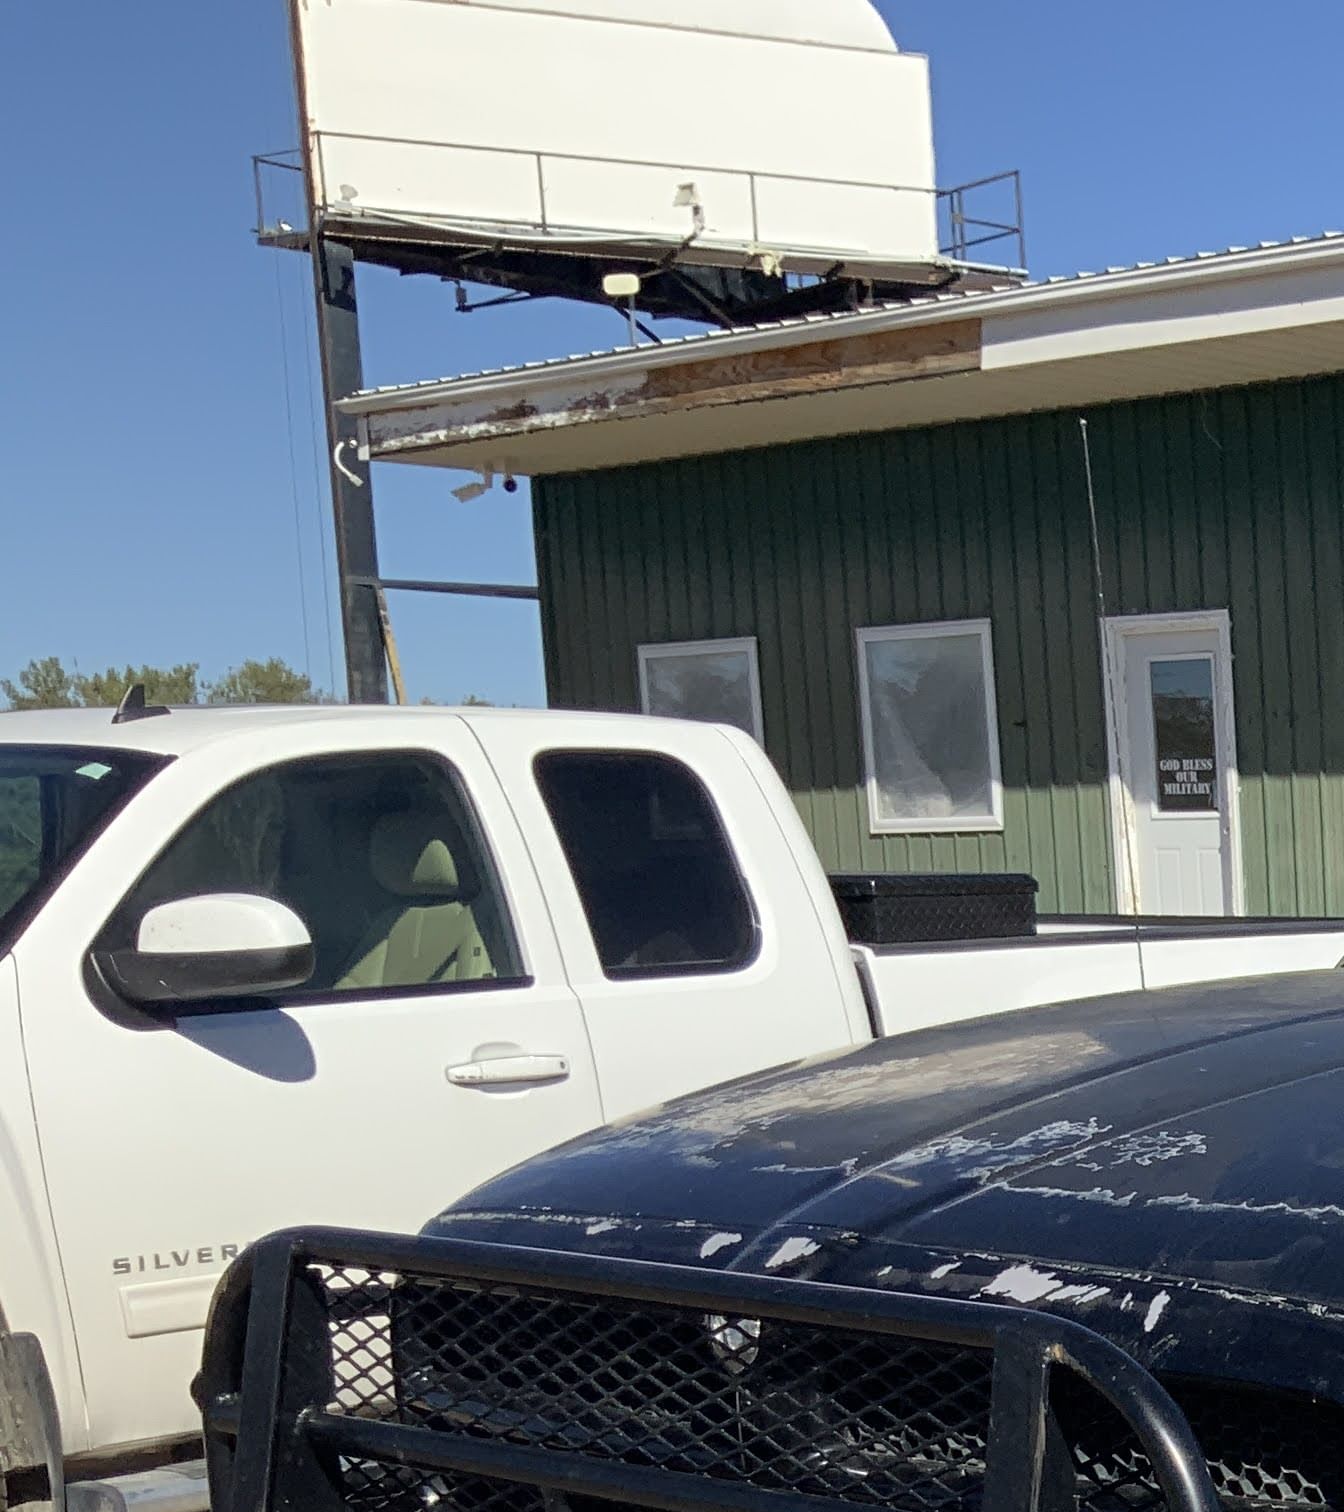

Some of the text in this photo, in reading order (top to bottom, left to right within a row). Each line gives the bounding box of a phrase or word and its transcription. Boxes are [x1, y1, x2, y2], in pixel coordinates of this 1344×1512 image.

[1160, 758, 1213, 771] GOD BLESS
[1176, 771, 1198, 782] OUR
[1164, 782, 1211, 795] MILITARY
